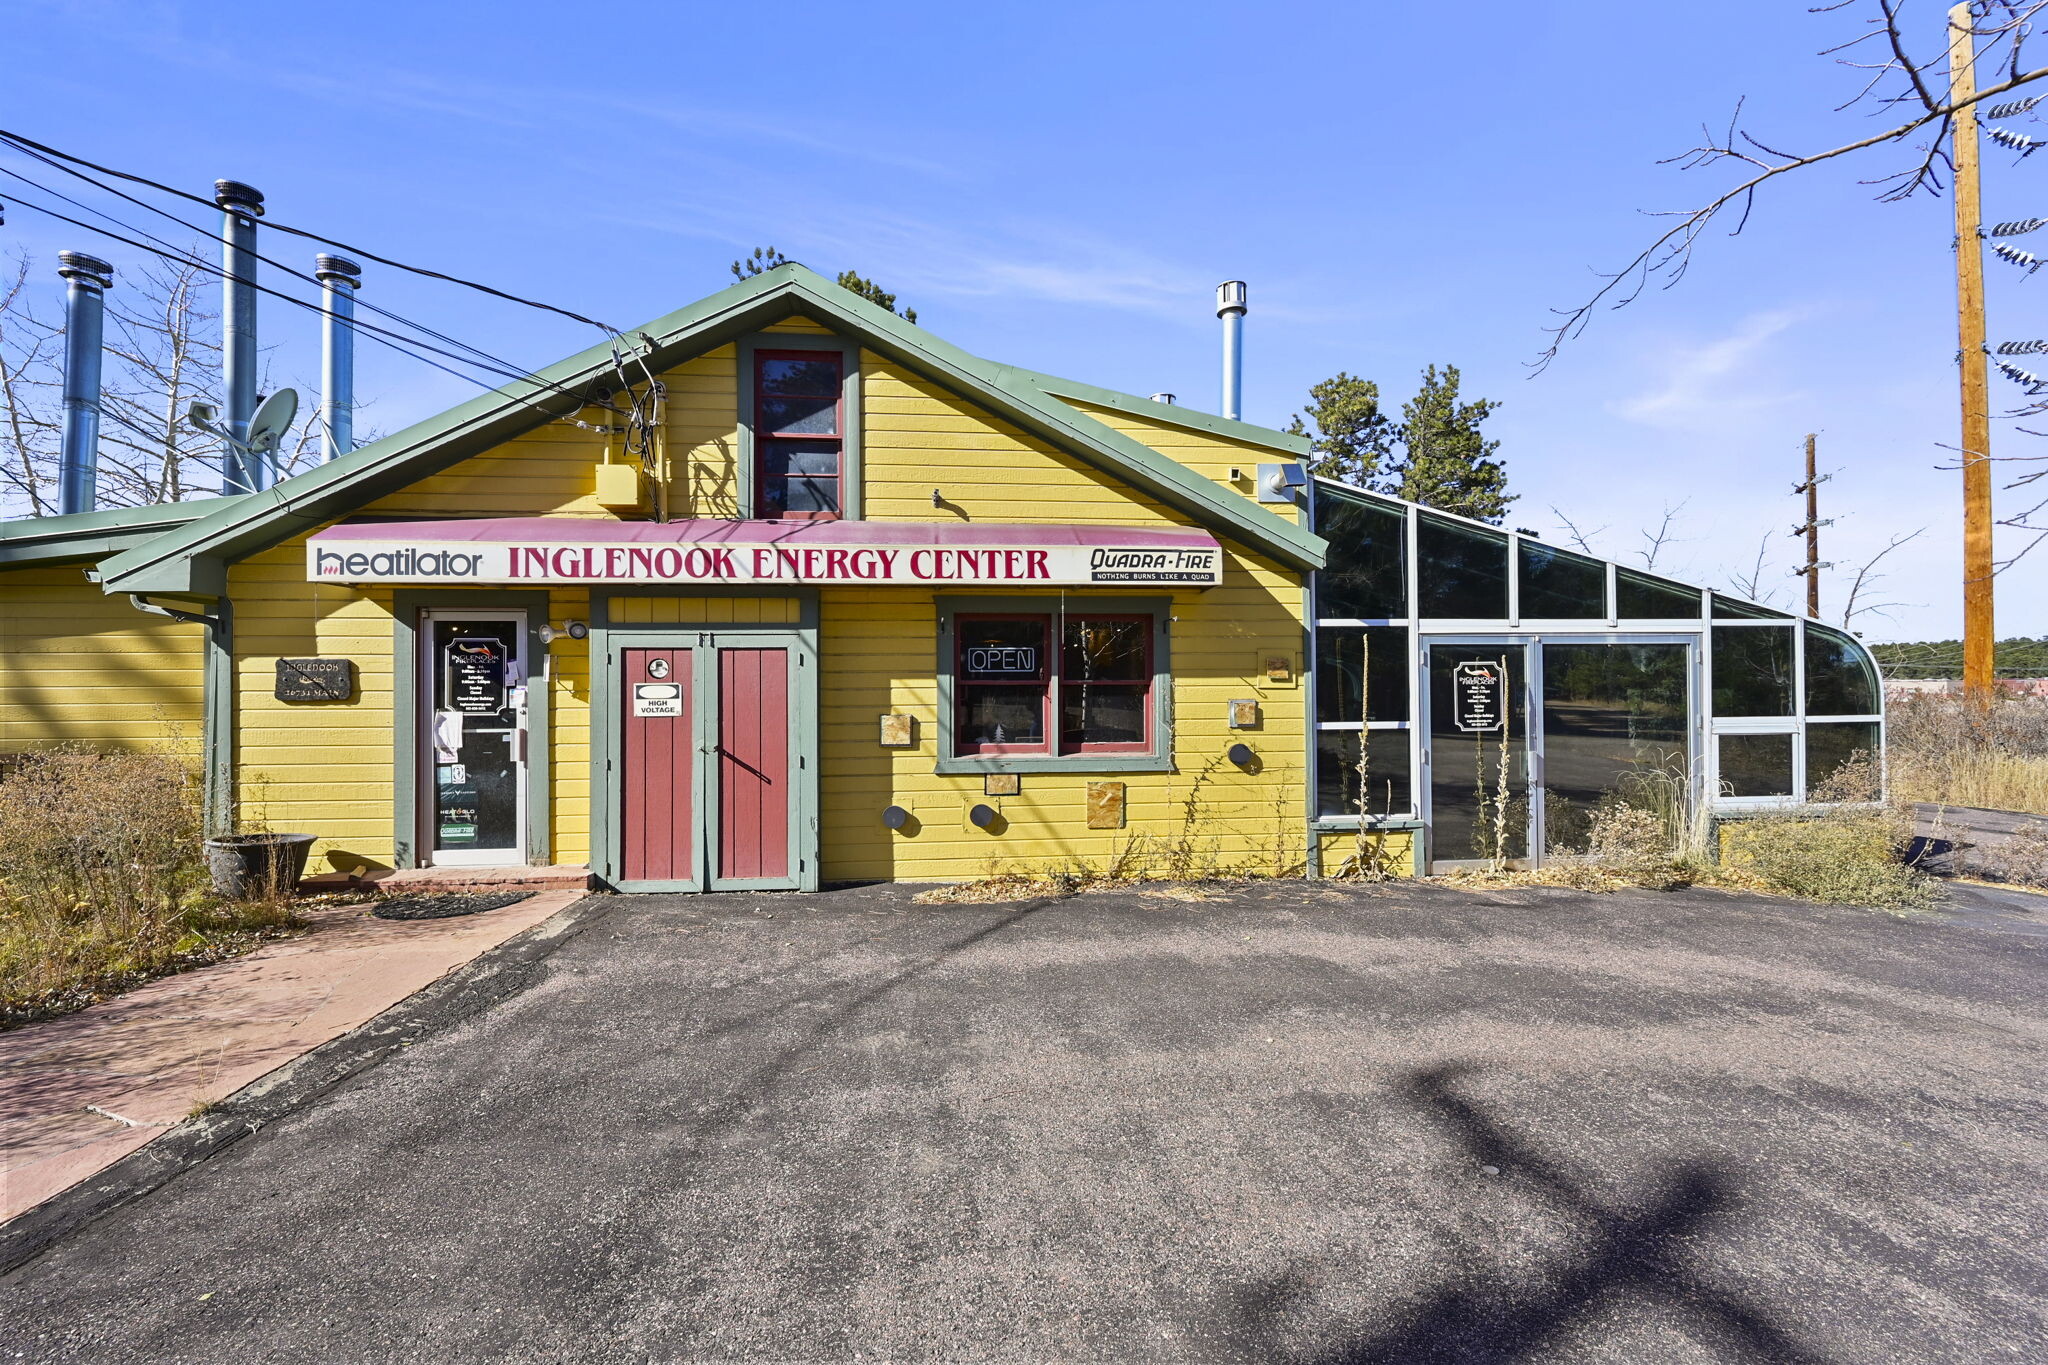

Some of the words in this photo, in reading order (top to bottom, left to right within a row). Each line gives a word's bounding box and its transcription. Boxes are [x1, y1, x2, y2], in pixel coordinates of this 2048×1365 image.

[317, 547, 482, 576] heatilator
[508, 547, 737, 578] INGLENOOK
[752, 548, 900, 579] ENERGY
[910, 549, 1051, 579] CENTER
[971, 650, 1031, 669] OPEN
